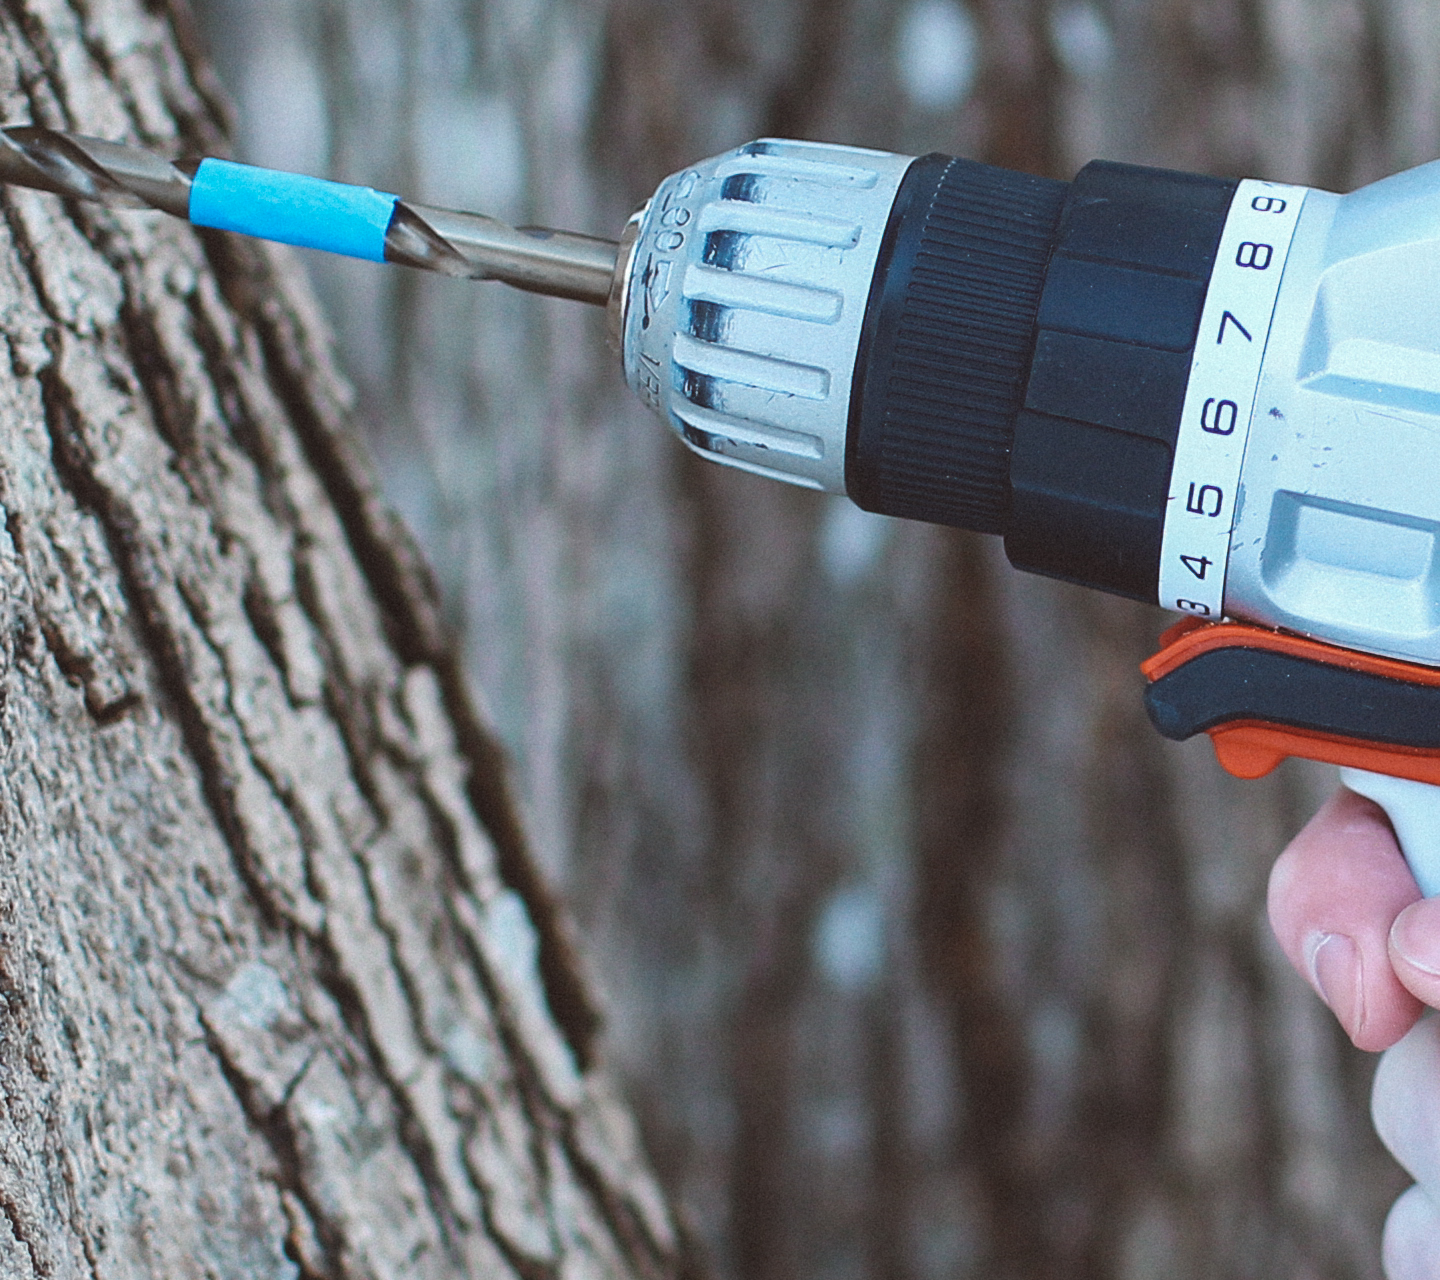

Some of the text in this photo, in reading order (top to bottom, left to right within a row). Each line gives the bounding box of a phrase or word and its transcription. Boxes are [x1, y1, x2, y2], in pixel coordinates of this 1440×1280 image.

[1175, 195, 1288, 617] 3 4 5 6 7 8 9
